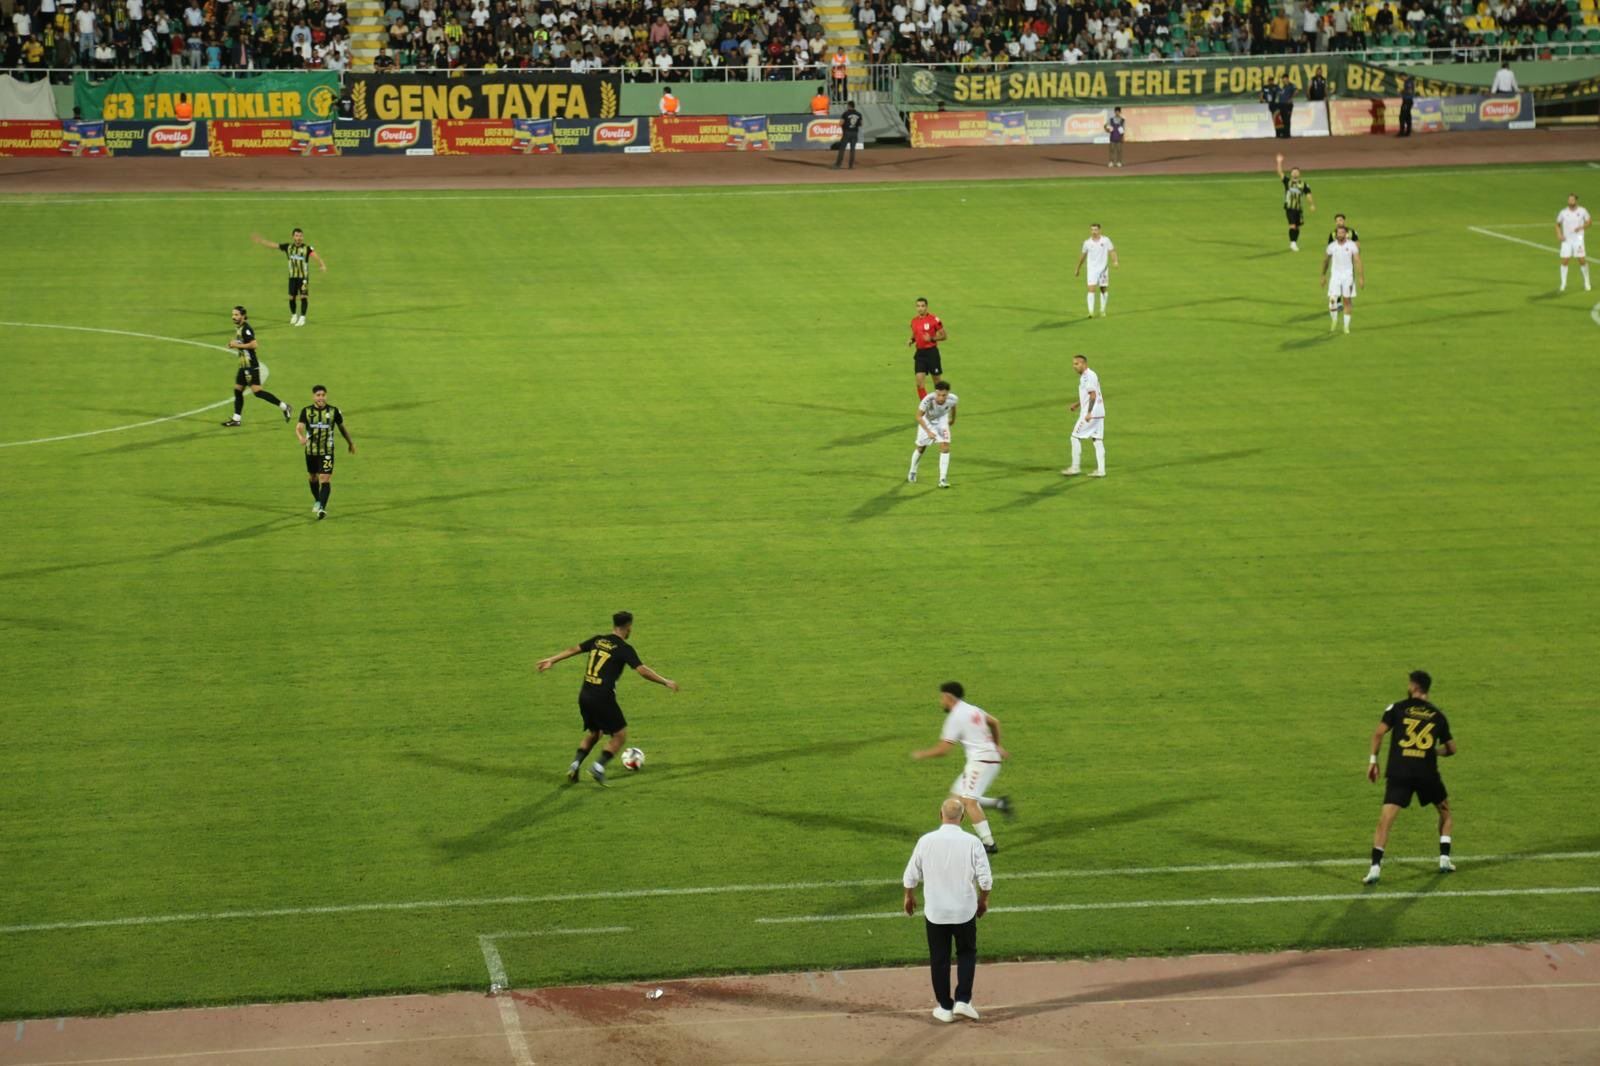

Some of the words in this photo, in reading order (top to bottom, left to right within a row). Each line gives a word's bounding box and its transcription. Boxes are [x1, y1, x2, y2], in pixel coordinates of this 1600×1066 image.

[953, 74, 1001, 101] SEN
[1008, 71, 1108, 100] SAHADA
[1115, 68, 1208, 96] TERLET
[481, 84, 590, 120] TAYFA
[587, 649, 612, 677] 17
[1398, 717, 1436, 750] 36
